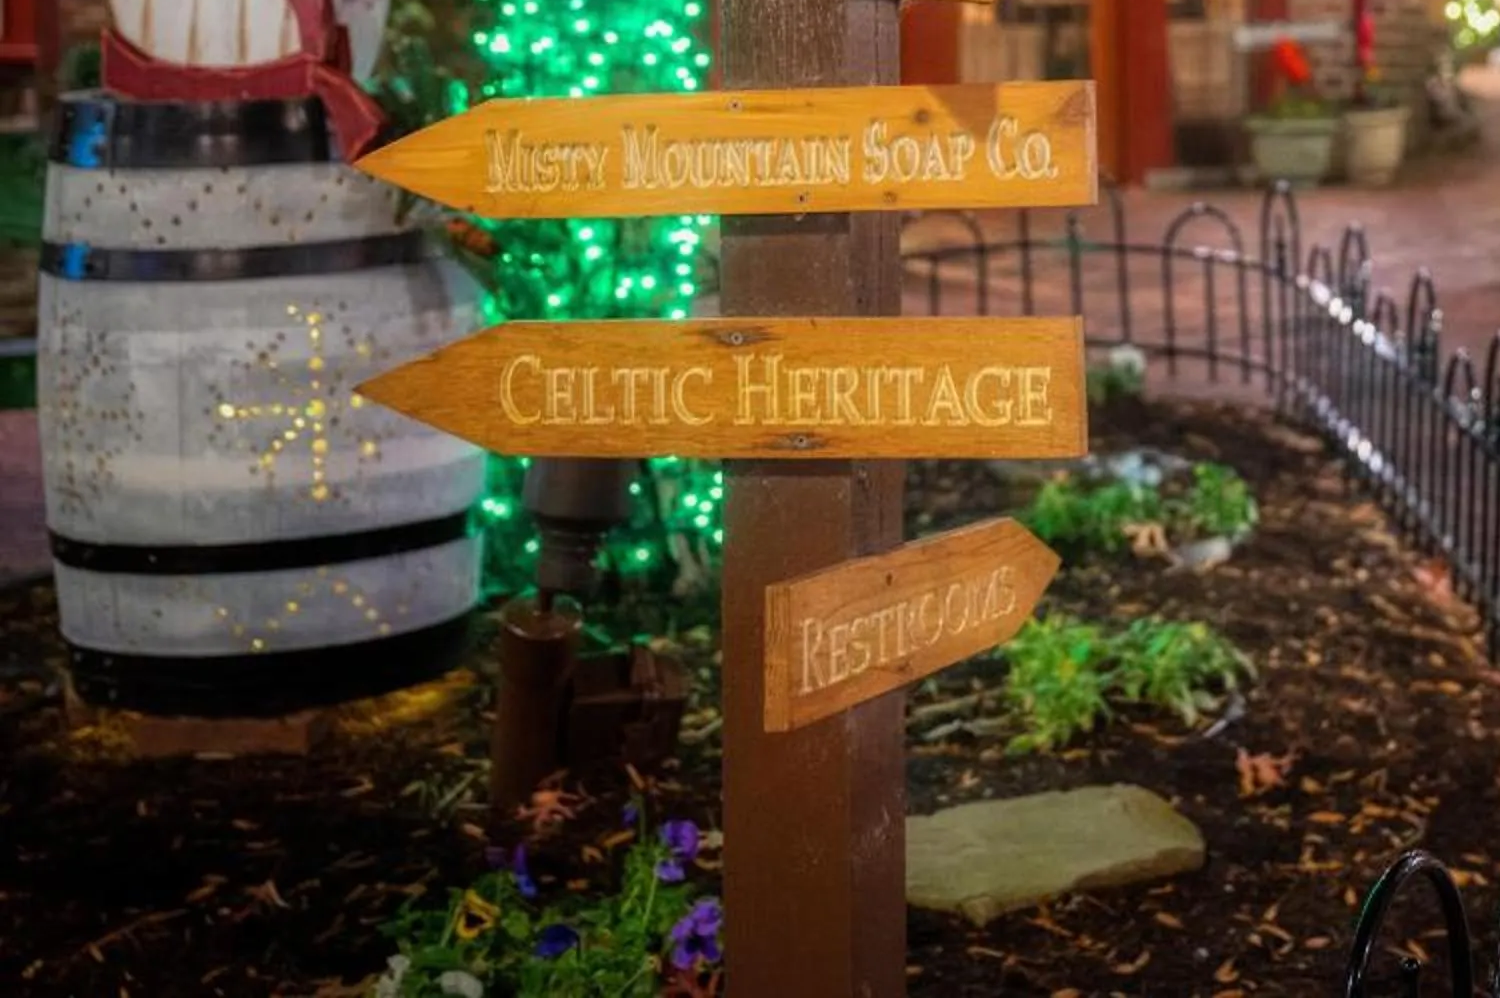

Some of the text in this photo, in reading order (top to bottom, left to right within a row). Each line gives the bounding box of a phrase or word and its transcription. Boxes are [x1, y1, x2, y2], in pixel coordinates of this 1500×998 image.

[484, 128, 609, 193] MISTY
[621, 122, 853, 190] MOUNTAIN
[862, 117, 976, 185] SOAP
[500, 353, 1055, 428] CELTIC HERITAGE
[799, 565, 1017, 694] RESTROOMS
